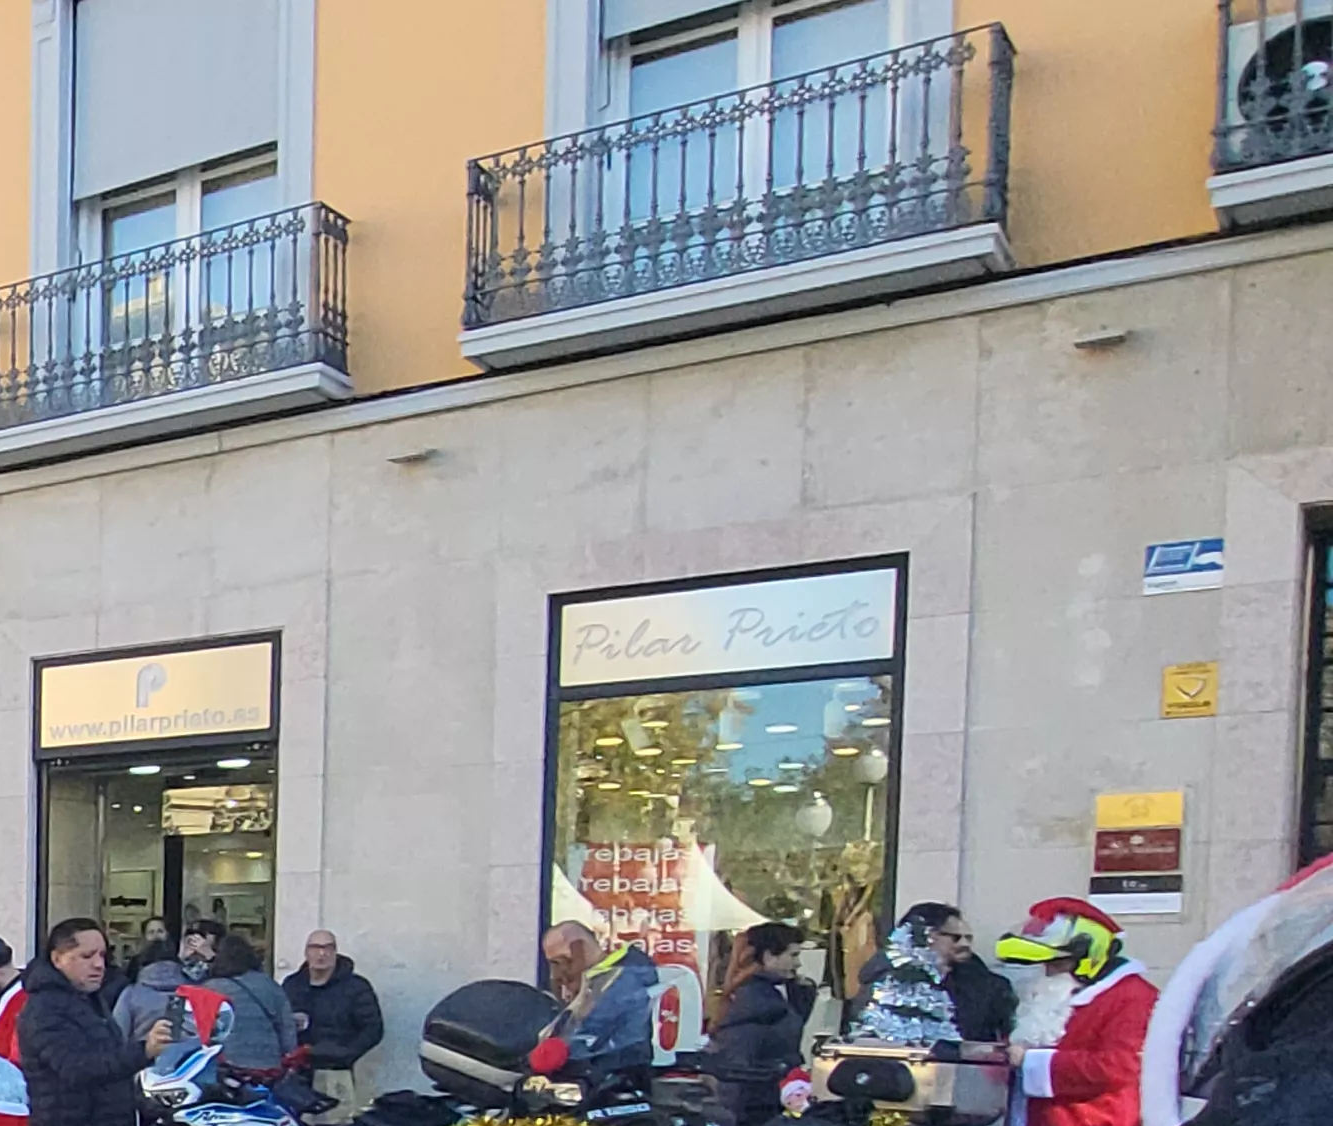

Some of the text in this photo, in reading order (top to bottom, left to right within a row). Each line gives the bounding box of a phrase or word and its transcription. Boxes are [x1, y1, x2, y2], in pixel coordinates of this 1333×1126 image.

[571, 599, 880, 666] Pilar Prieto
[48, 706, 260, 740] www.pilarprieto.es
